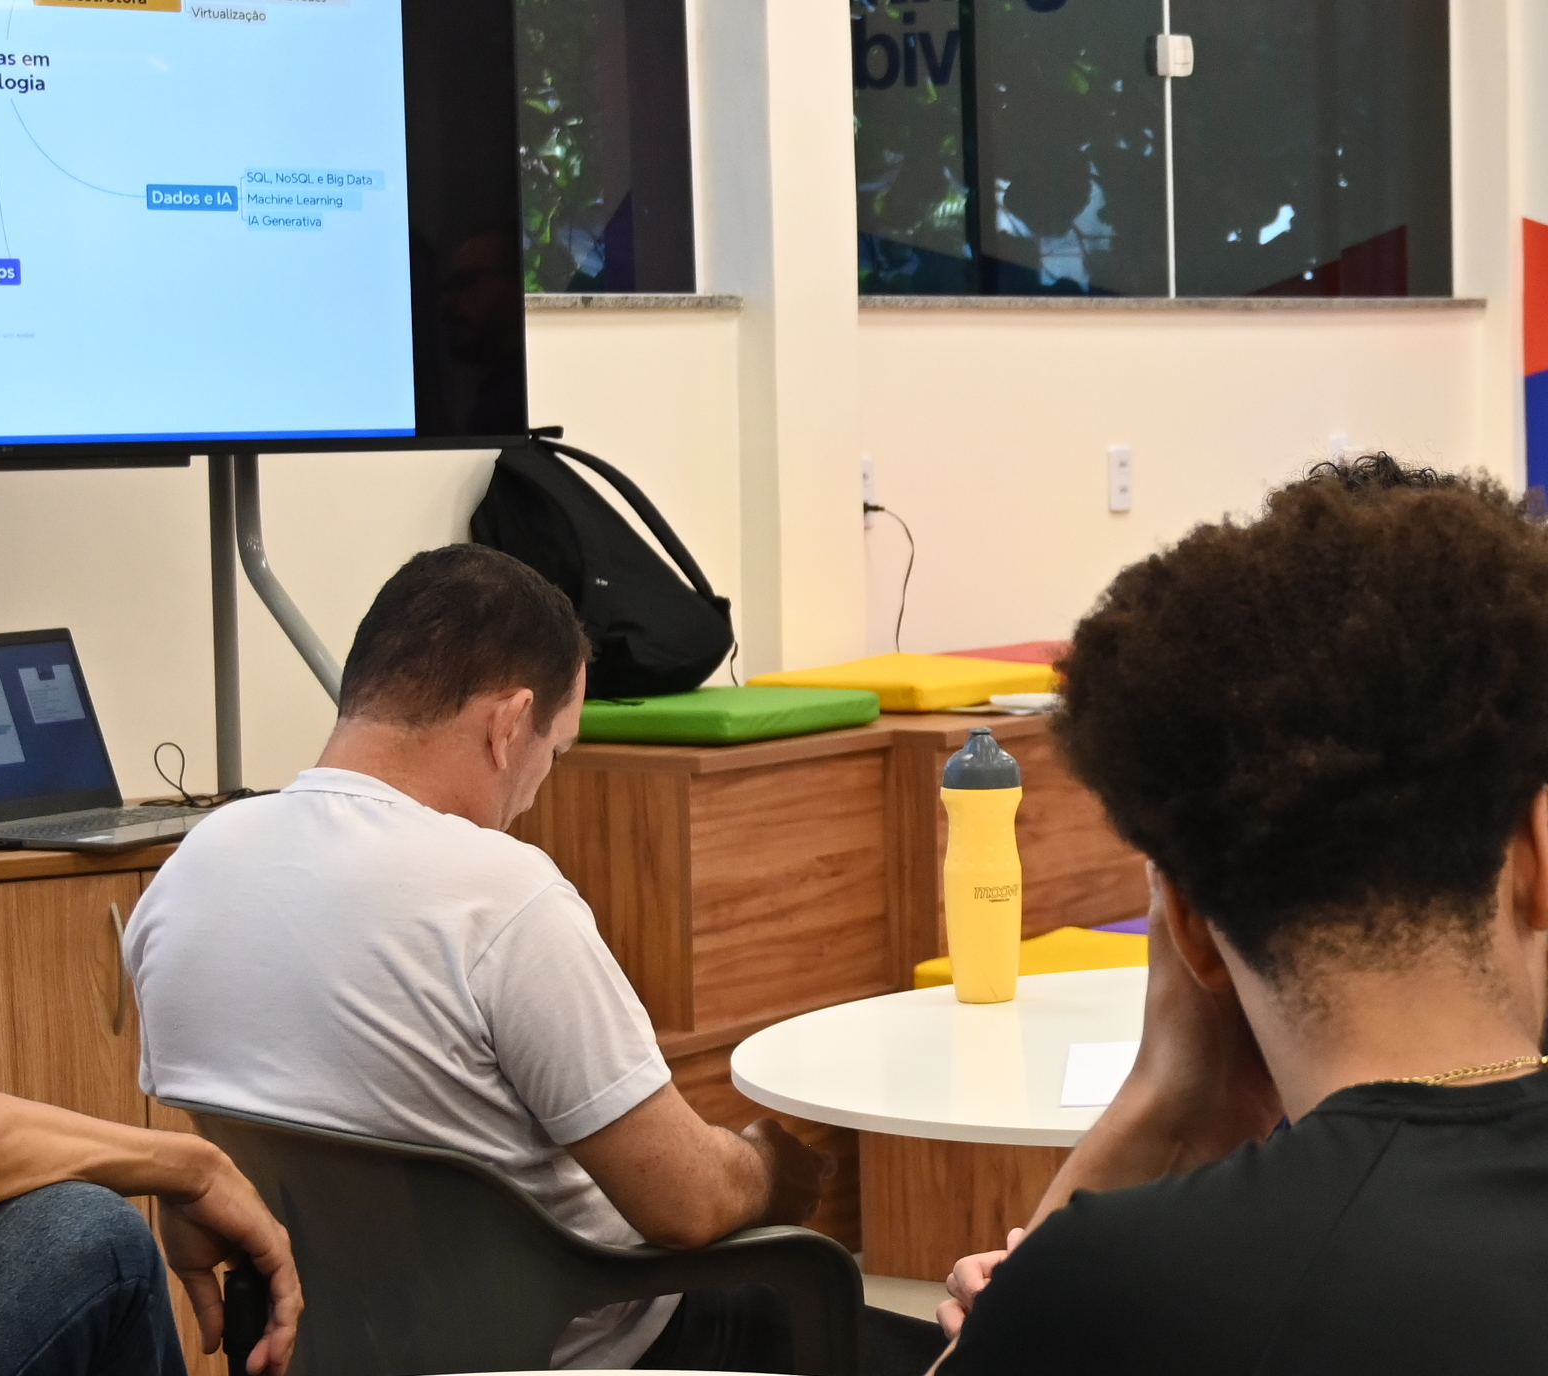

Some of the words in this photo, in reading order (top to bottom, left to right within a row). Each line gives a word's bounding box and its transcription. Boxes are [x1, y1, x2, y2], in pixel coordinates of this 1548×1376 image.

[191, 7, 267, 23] Virtualização
[22, 52, 50, 67] em
[246, 171, 273, 186] SQL,
[275, 172, 315, 186] NoSQL
[317, 176, 324, 185] e
[326, 173, 344, 188] Big
[347, 173, 373, 186] Data
[152, 190, 201, 206] Dados
[204, 193, 214, 205] e
[217, 191, 233, 206] IA
[247, 192, 294, 206] Machine
[297, 194, 343, 208] Learning
[248, 214, 260, 227] IA
[262, 214, 322, 227] Generativa
